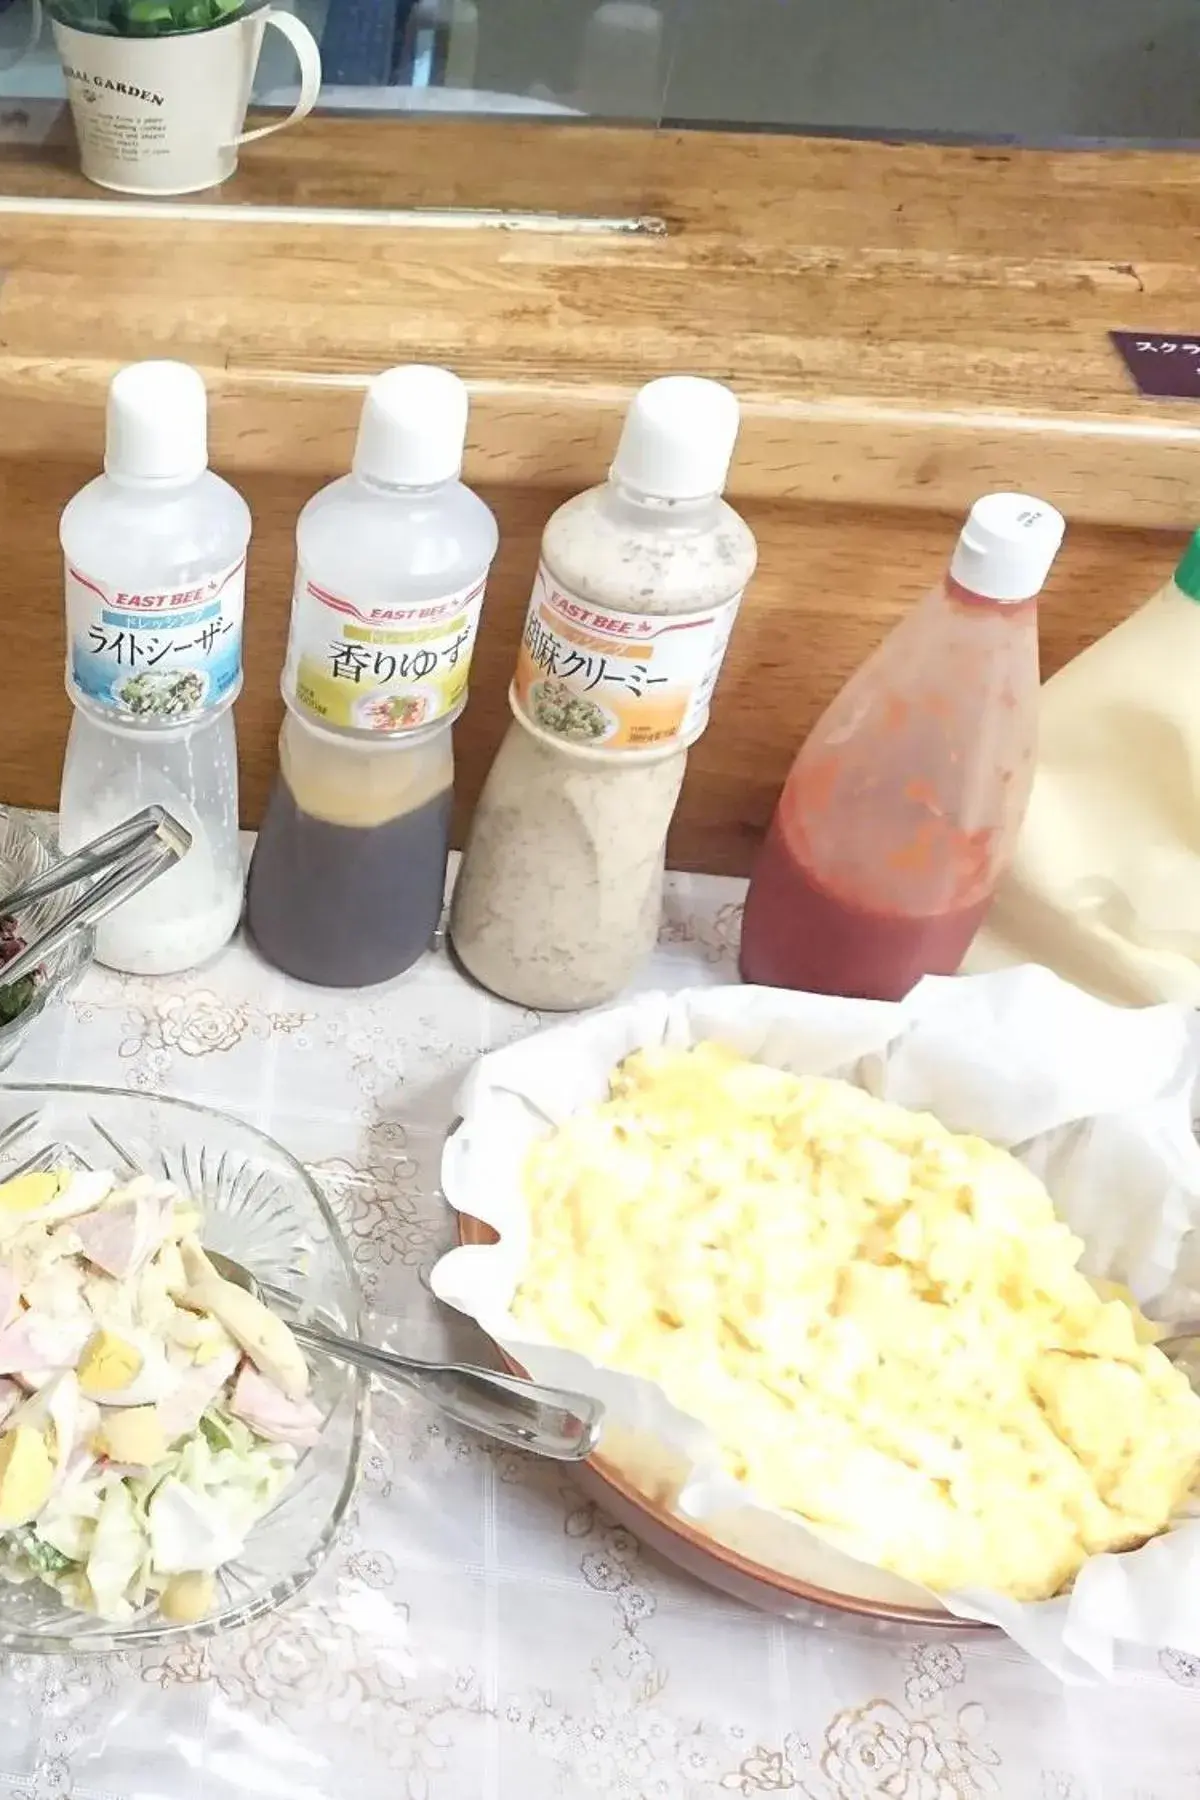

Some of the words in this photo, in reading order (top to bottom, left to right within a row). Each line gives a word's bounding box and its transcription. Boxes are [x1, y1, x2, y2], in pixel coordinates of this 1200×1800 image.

[93, 76, 164, 107] GARDEN
[116, 593, 164, 608] EAST
[169, 589, 203, 606] BEE
[370, 608, 415, 620] EAST
[420, 607, 447, 619] BEE
[551, 591, 594, 622] EAST
[592, 615, 637, 634] BEE
[88, 617, 234, 666] ライトシーザー
[328, 624, 472, 685] 香りゆず
